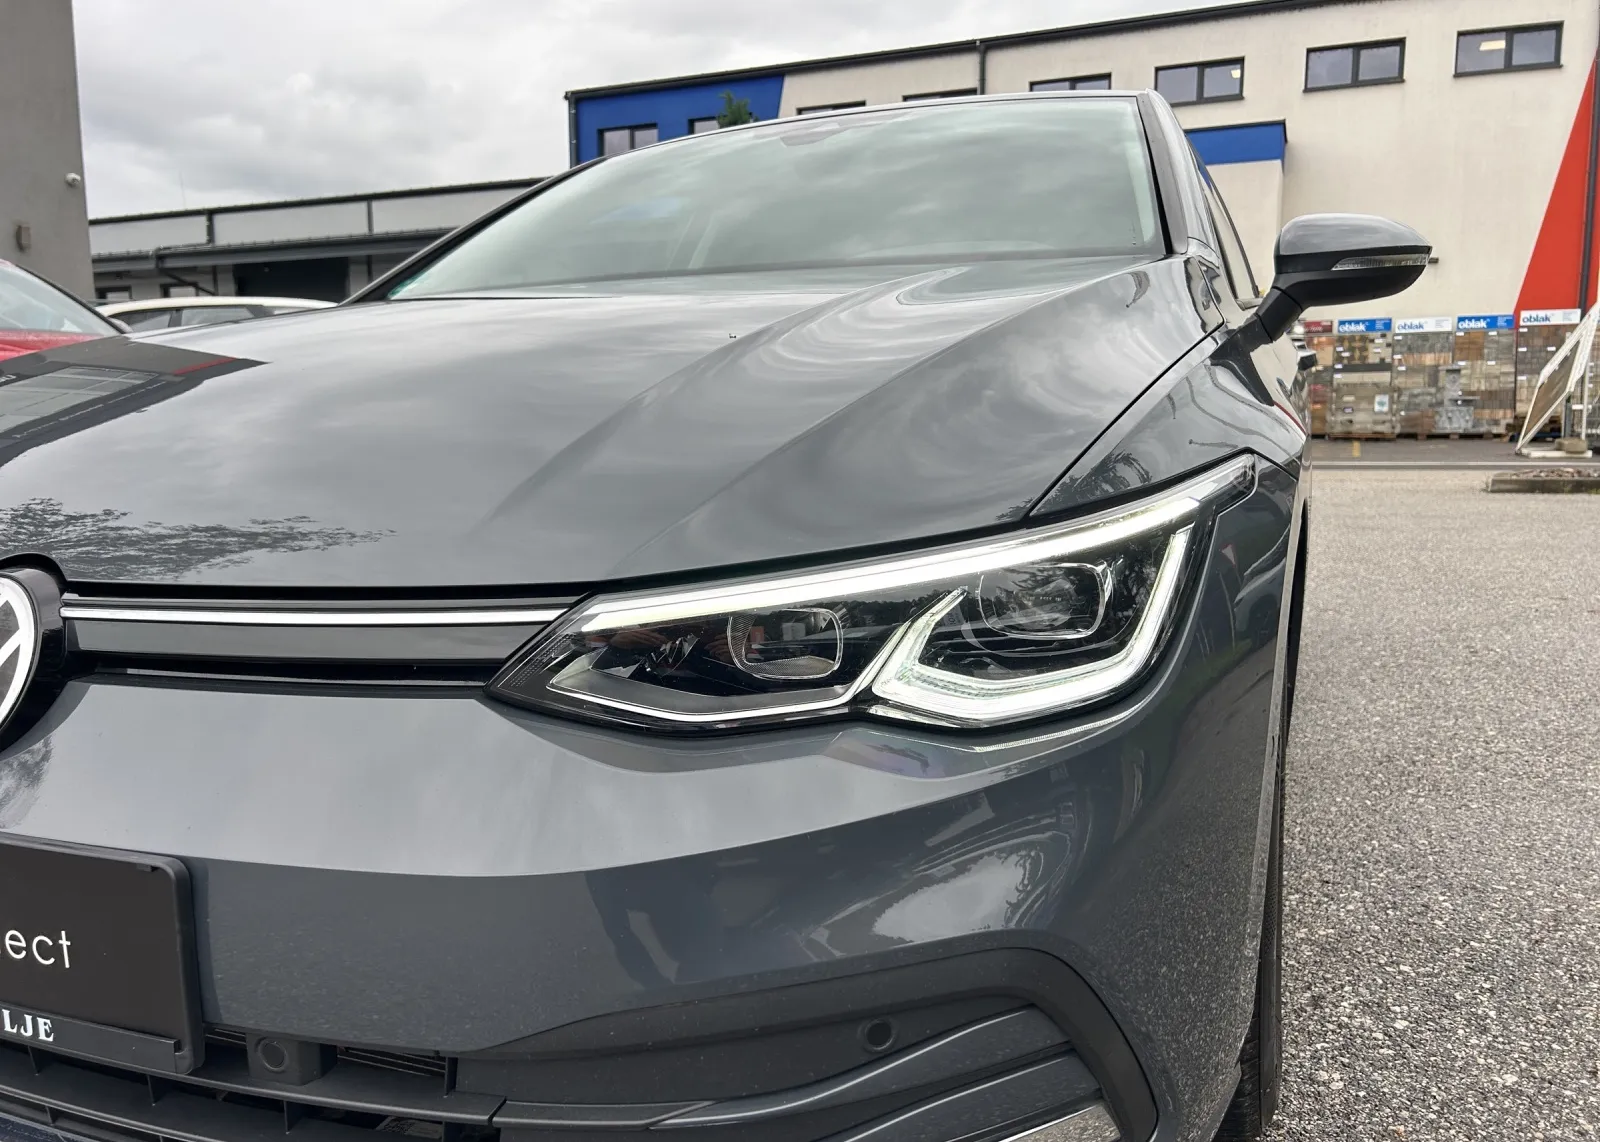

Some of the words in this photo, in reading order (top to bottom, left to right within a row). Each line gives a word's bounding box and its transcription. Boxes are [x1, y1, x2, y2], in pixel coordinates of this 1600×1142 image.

[1458, 318, 1487, 329] oblak
[1522, 314, 1551, 324] oblak
[1338, 321, 1367, 332] oblak
[1397, 320, 1424, 331] oblak
[0, 929, 72, 968] ect
[1, 1008, 55, 1042] LJE
